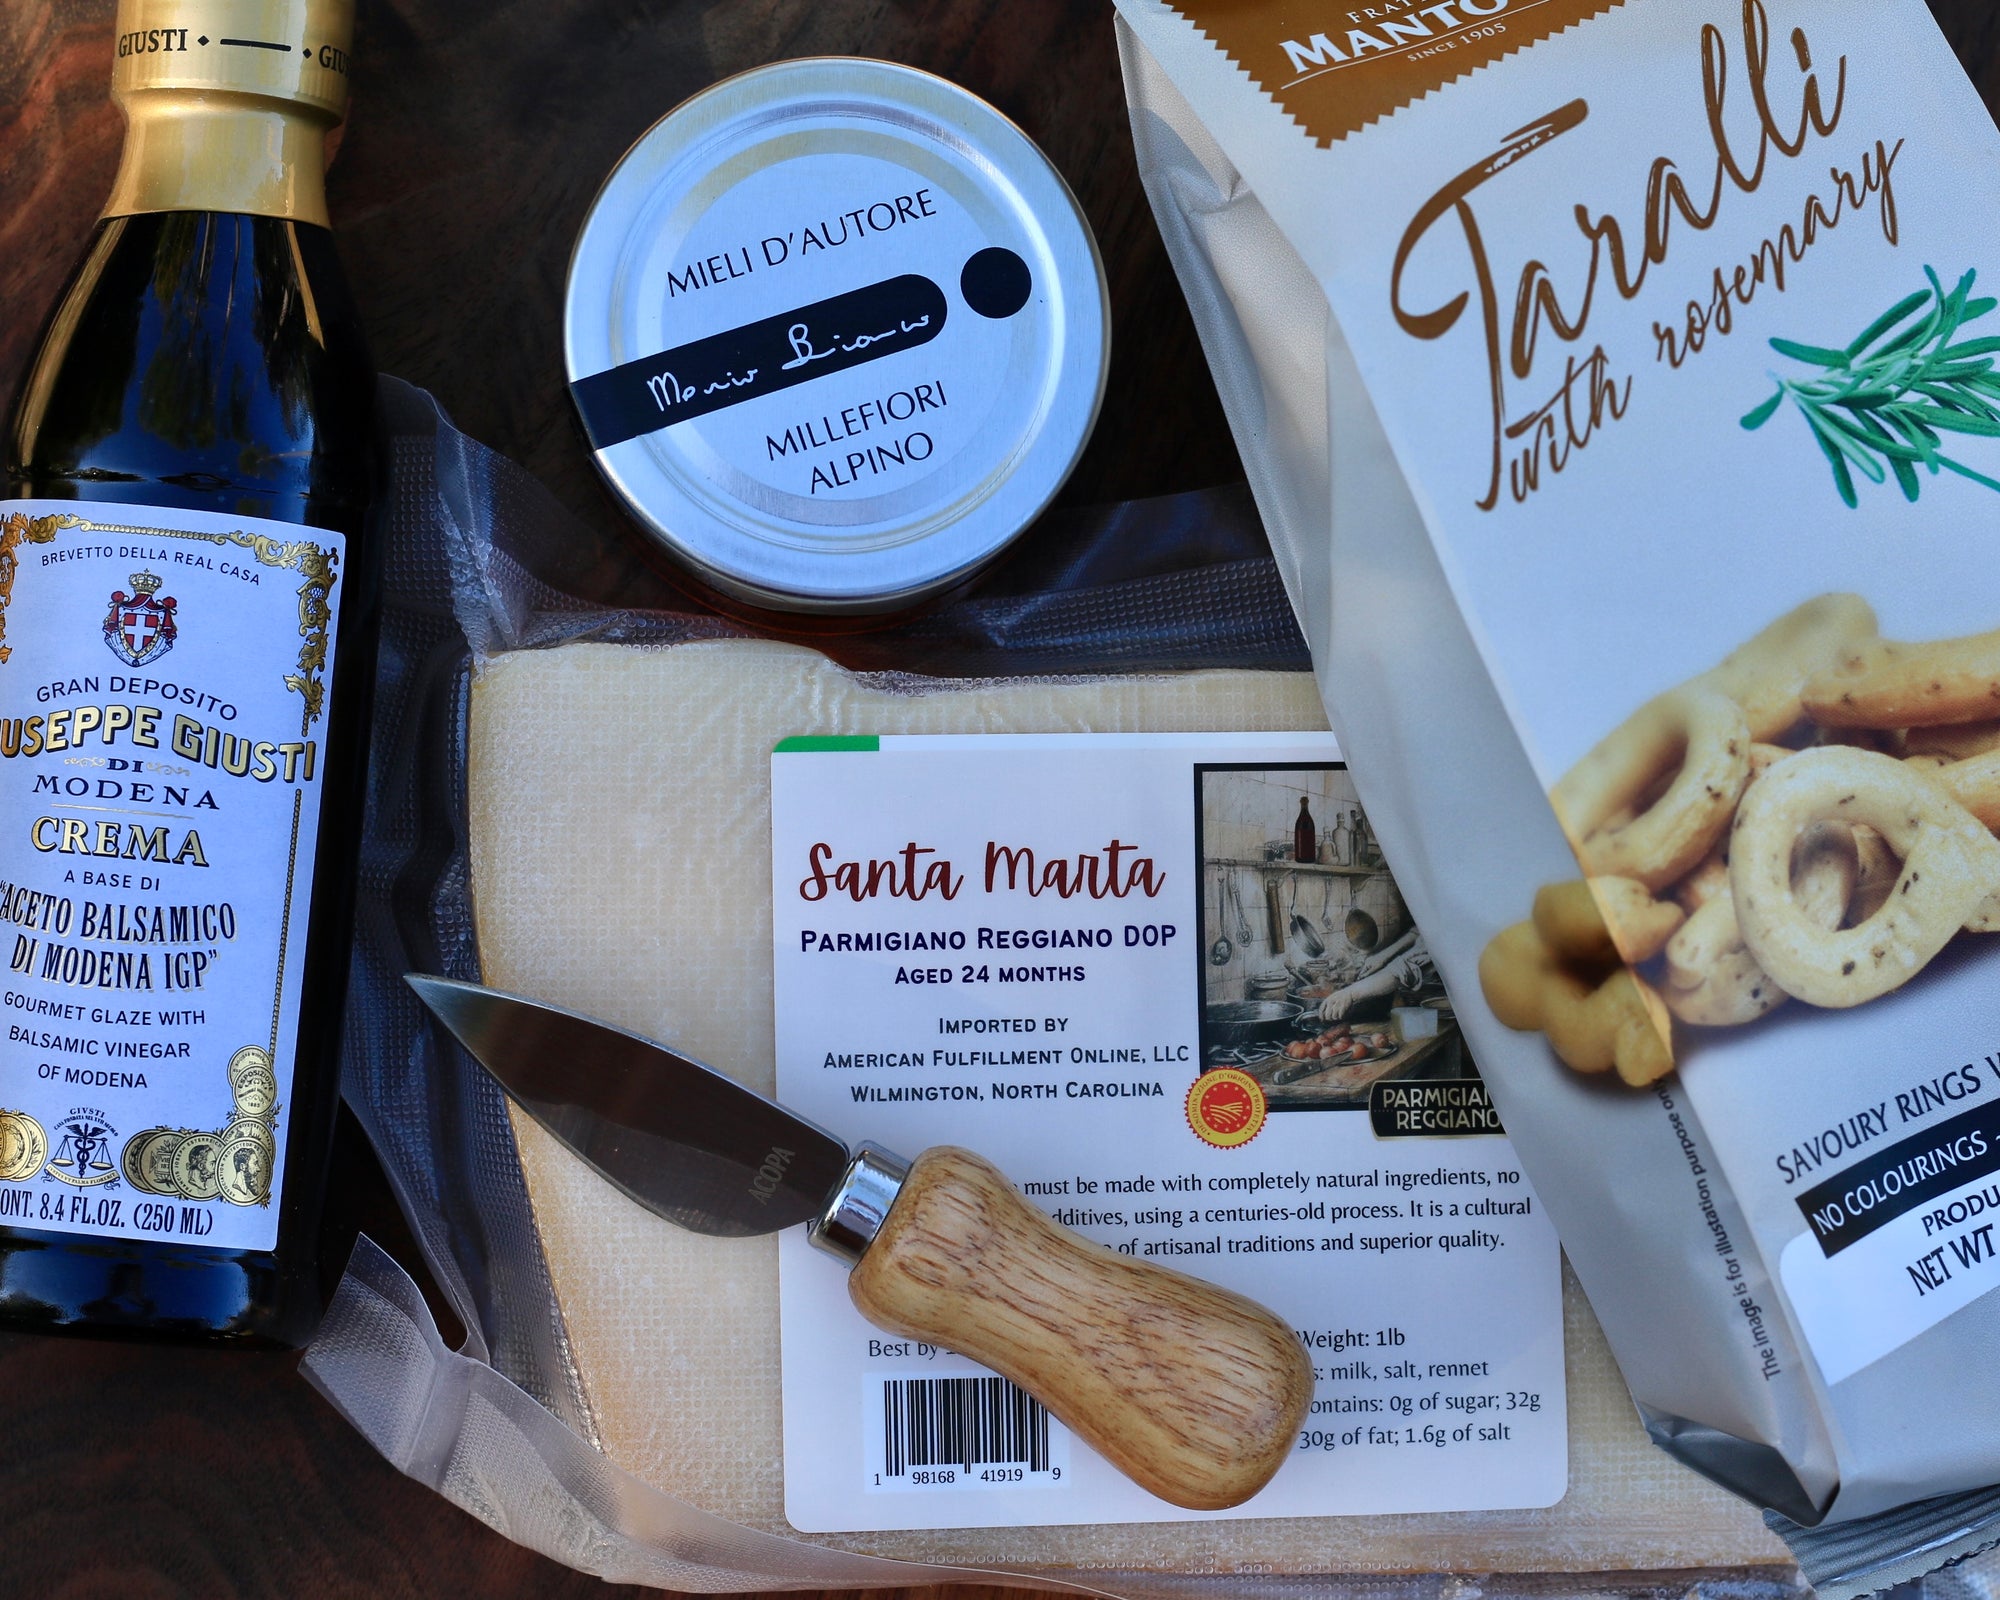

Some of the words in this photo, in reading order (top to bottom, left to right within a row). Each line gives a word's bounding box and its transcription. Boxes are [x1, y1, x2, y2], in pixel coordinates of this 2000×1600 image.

[118, 28, 188, 58] GIUSTI
[1407, 41, 1457, 62] SINCE
[1459, 22, 1506, 45] 1905
[666, 246, 755, 298] MIELI
[761, 188, 937, 267] D’AUTORE
[1390, 0, 1848, 513] Taralli
[1504, 343, 1633, 503] with
[1652, 138, 1905, 367] rosemary
[765, 379, 948, 462] MILLEFIORI
[809, 431, 934, 495] ALPINO
[41, 545, 113, 567] BREVETTO
[119, 546, 168, 562] DELLA
[174, 551, 214, 571] REAL
[220, 562, 260, 586] CASA
[36, 676, 99, 702] GRAN
[109, 676, 238, 721] DEPOSITO
[0, 704, 162, 759] USEPPE
[171, 712, 317, 783] GIUSTI
[106, 757, 144, 774] DI
[32, 774, 220, 810] MODENA
[31, 816, 209, 867] CREMA
[64, 870, 75, 884] A
[83, 871, 132, 889] BASE
[140, 876, 160, 891] DI
[799, 841, 964, 902] Santa
[983, 839, 1166, 899] Marta
[80, 901, 237, 944] BALSAMICO
[800, 929, 966, 953] PARMIGIANO
[977, 926, 1113, 951] REGGIANO
[1123, 924, 1178, 948] DOP
[10, 933, 38, 974] DI
[41, 943, 153, 992] MODENA
[894, 966, 953, 985] AGED
[961, 966, 990, 984] 24
[998, 965, 1086, 984] MONTHS
[4, 991, 86, 1021] GOURMET
[91, 1008, 152, 1026] GLAZE
[158, 1010, 206, 1026] WITH
[9, 1025, 99, 1055] BALSAMIC
[104, 1041, 191, 1059] VINEGAR
[938, 1017, 1037, 1035] IMPORTED
[1044, 1017, 1069, 1033] BY
[823, 1051, 925, 1069] AMERICAN
[932, 1048, 1063, 1068] FULFILLMENT
[1069, 1047, 1147, 1066] ONLINE,
[1153, 1045, 1190, 1063] LLC
[38, 1063, 61, 1081] OF
[65, 1067, 148, 1089] MODENA
[237, 1069, 274, 1092] ESPOSIZIONE
[850, 1085, 985, 1103] WILMINGTON,
[991, 1083, 1058, 1101] NORTH
[1065, 1081, 1164, 1099] CAROLINA
[69, 1107, 106, 1119] GIVSTI
[1383, 1087, 1488, 1108] PARMIGIA
[1396, 1108, 1500, 1130] REGGIANO
[1776, 1102, 1888, 1185] SAVOURY
[1895, 1063, 1982, 1124] RINGS
[1669, 1111, 1707, 1176] purpose
[747, 1146, 796, 1206] ACOPA
[1024, 1180, 1070, 1195] must
[1076, 1176, 1098, 1194] be
[1105, 1175, 1155, 1194] made
[1162, 1173, 1202, 1192] with
[1208, 1170, 1310, 1196] completely
[1316, 1168, 1378, 1189] natural
[1384, 1166, 1492, 1190] ingredients,
[1498, 1169, 1520, 1184] no
[1812, 1202, 1845, 1236] NO
[1844, 1129, 1988, 1209] COLOURINGS
[0, 1188, 33, 1218] ONT.
[39, 1193, 64, 1221] 8.4
[70, 1196, 125, 1228] FL.OZ.
[133, 1202, 174, 1233] (250
[180, 1206, 214, 1236] ML)
[1052, 1207, 1128, 1227] dditives,
[1134, 1206, 1183, 1228] using
[1189, 1212, 1199, 1222] a
[1205, 1200, 1325, 1223] centuries-old
[1331, 1203, 1403, 1226] process.
[1410, 1202, 1424, 1217] It
[1429, 1202, 1444, 1216] is
[1449, 1205, 1459, 1217] a
[1465, 1197, 1531, 1216] cultural
[1118, 1237, 1139, 1256] of
[1144, 1235, 1221, 1256] artisanal
[1227, 1232, 1315, 1254] traditions
[1321, 1231, 1354, 1251] and
[1359, 1231, 1433, 1254] superior
[1438, 1228, 1505, 1253] quality.
[1726, 1257, 1743, 1281] for
[1906, 1246, 1952, 1297] NET
[1948, 1223, 1996, 1269] WT
[1732, 1281, 1748, 1297] is
[1740, 1298, 1770, 1348] image
[868, 1339, 910, 1357] Best
[917, 1341, 938, 1360] by
[1296, 1329, 1370, 1352] Weight:
[1376, 1327, 1405, 1347] 1lb
[1330, 1361, 1377, 1381] milk,
[1383, 1360, 1422, 1380] salt,
[1428, 1360, 1489, 1378] rennet
[1761, 1347, 1781, 1381] The
[1310, 1395, 1383, 1414] ontains:
[1389, 1395, 1413, 1416] 0g
[1419, 1391, 1441, 1410] of
[1445, 1394, 1500, 1414] sugar;
[1506, 1391, 1541, 1413] 32g
[1299, 1429, 1335, 1451] 30g
[1341, 1426, 1362, 1445] of
[1367, 1425, 1399, 1446] fat;
[1405, 1424, 1446, 1447] 1.6g
[1452, 1423, 1474, 1442] of
[1478, 1422, 1511, 1441] salt
[873, 1473, 882, 1486] 1
[912, 1470, 955, 1484] 98168
[980, 1468, 1023, 1482] 41919
[1052, 1467, 1061, 1481] 9
